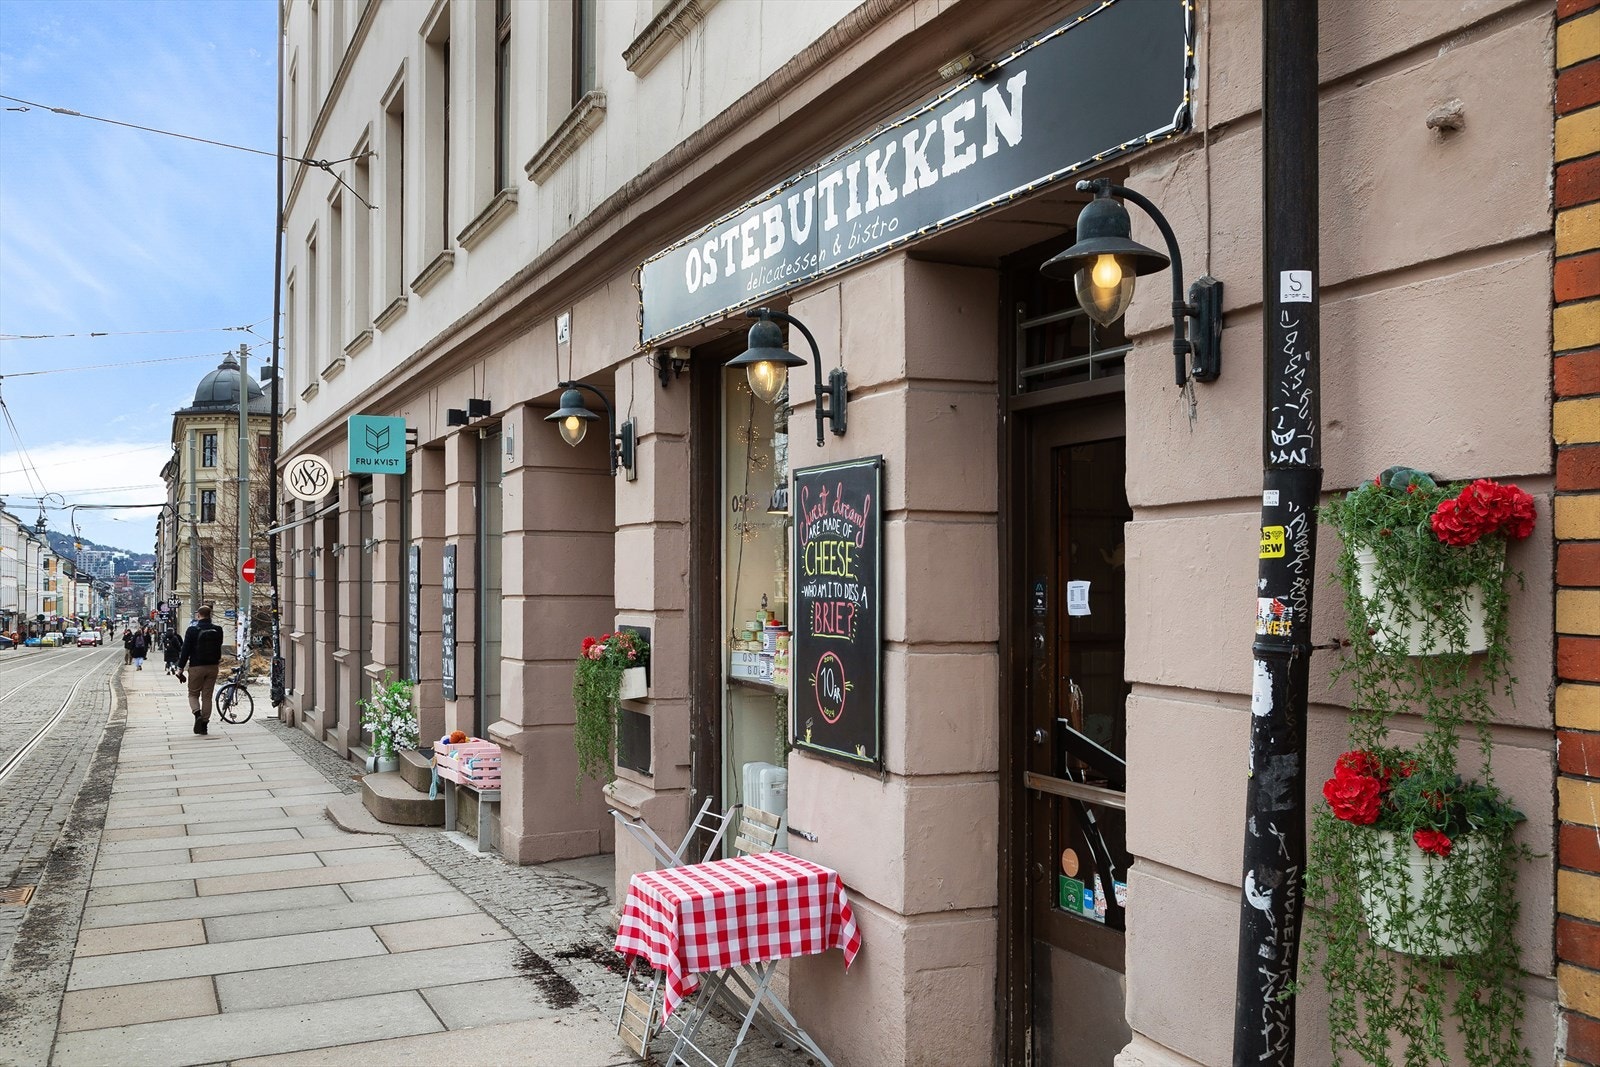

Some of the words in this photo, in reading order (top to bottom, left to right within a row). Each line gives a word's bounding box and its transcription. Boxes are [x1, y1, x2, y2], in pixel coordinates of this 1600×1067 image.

[685, 70, 1027, 293] OSTEBUTIKKEN
[746, 249, 826, 291] delicatessen
[833, 234, 842, 256] &
[848, 215, 899, 249] bistro
[355, 457, 372, 466] FRU
[374, 458, 400, 466] KVIST
[808, 520, 821, 539] ARE
[822, 517, 842, 535] MADE
[843, 522, 853, 539] OF
[805, 540, 856, 577] CHEESE
[817, 584, 827, 599] AM
[828, 582, 832, 598] I
[834, 582, 842, 598] TO
[844, 582, 860, 602] DISS
[861, 586, 868, 609] A
[815, 601, 855, 637] BRIE?
[820, 667, 835, 698] 10
